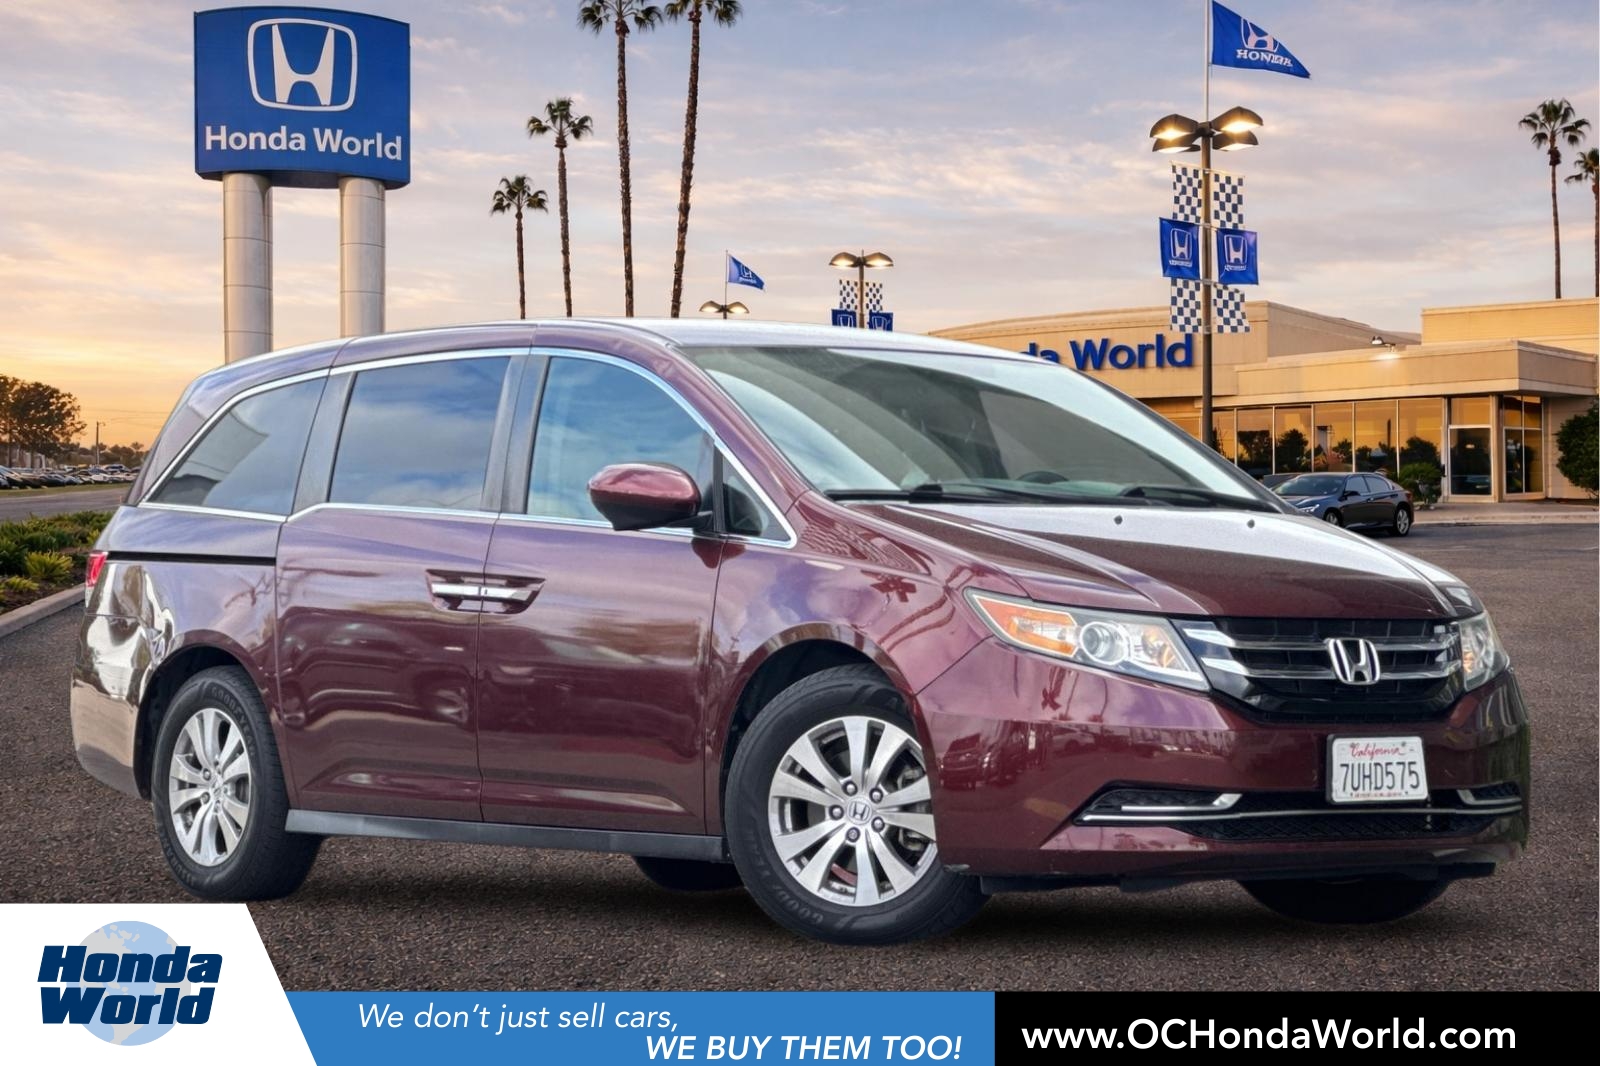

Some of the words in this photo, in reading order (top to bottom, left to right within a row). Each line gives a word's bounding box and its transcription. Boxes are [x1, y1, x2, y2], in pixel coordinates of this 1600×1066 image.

[205, 125, 306, 151] Honda
[313, 127, 402, 161] World
[1070, 333, 1194, 370] World
[1349, 742, 1407, 761] California
[1340, 761, 1420, 792] 7UHD575
